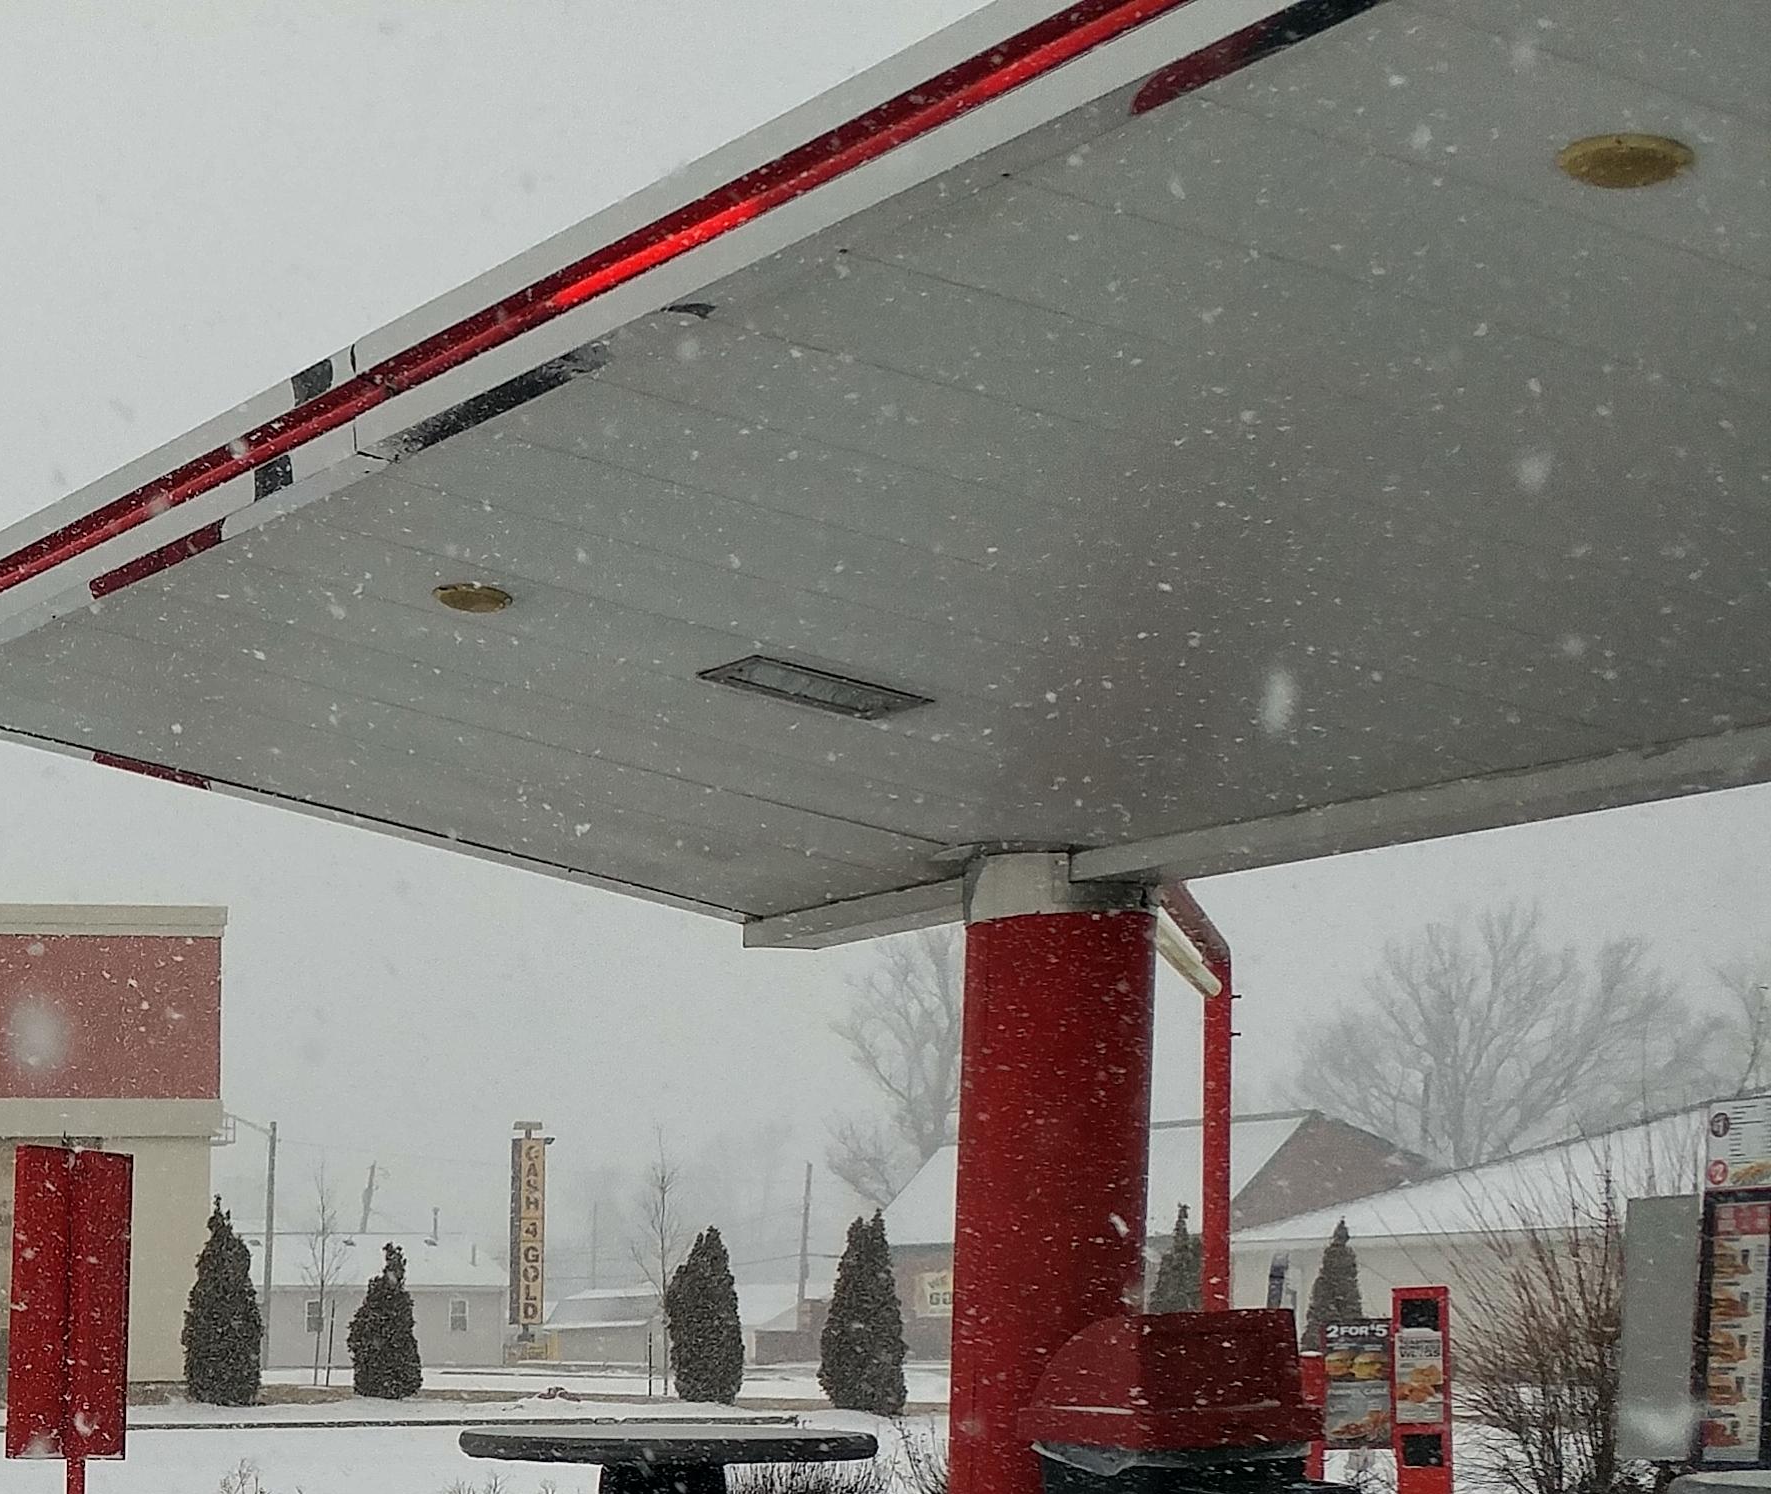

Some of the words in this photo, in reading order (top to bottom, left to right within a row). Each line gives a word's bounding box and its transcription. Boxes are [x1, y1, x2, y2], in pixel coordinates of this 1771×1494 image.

[524, 1144, 541, 1211] CASH
[524, 1222, 538, 1238] 4
[522, 1246, 541, 1320] GOLD
[1325, 1324, 1339, 1338] 2
[1339, 1325, 1370, 1337] FOR
